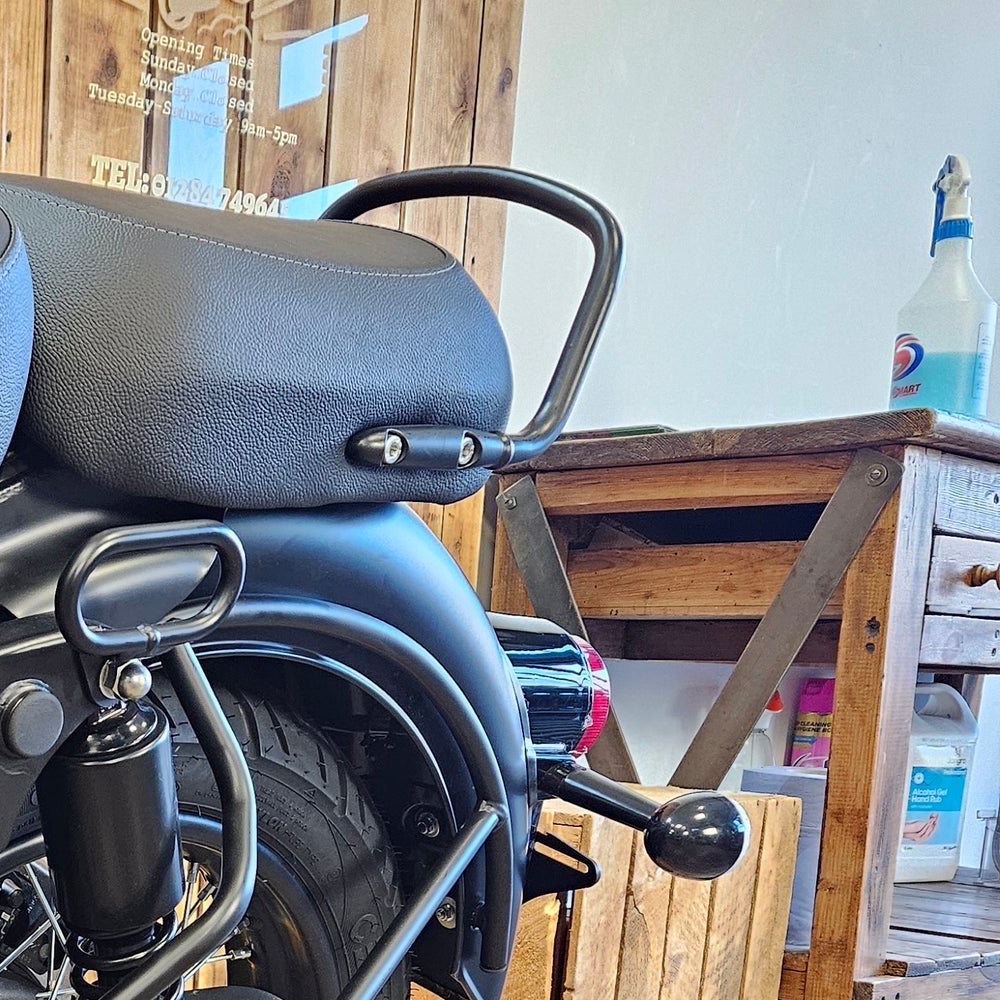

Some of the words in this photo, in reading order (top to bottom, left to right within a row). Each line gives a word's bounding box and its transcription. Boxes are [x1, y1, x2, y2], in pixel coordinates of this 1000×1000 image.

[141, 27, 205, 60] Opening
[213, 45, 255, 70] Times
[141, 50, 195, 79] Sunday
[911, 795, 930, 803] Hand
[930, 795, 943, 803] Rub
[912, 788, 936, 796] Alcohol
[937, 788, 948, 796] Gel
